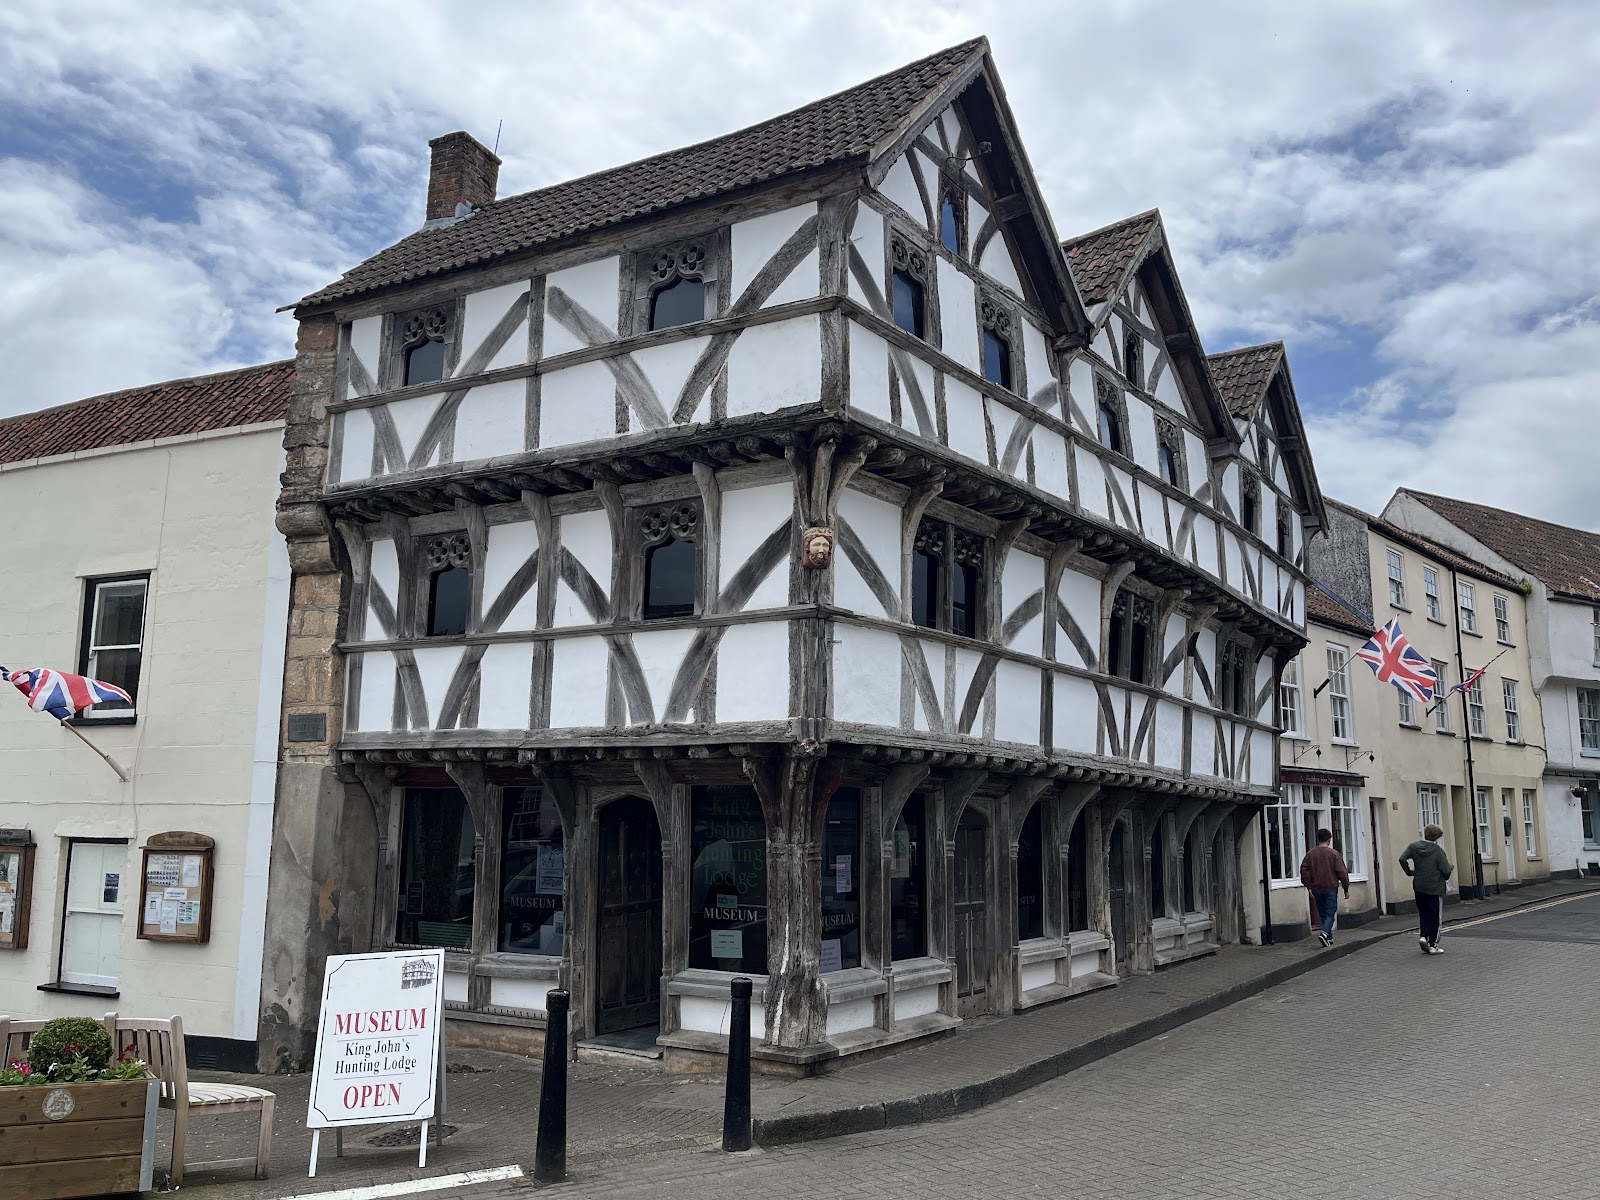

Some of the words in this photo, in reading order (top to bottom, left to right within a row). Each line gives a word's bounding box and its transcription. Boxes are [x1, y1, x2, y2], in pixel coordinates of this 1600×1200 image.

[712, 797, 751, 823] King
[705, 820, 757, 839] John's
[699, 841, 763, 871] Hunting
[703, 866, 758, 894] Lodge
[510, 896, 556, 909] MUSEUM
[703, 907, 758, 922] MUSEUM
[333, 1007, 427, 1035] MUSEUM
[345, 1042, 371, 1058] King
[374, 1038, 411, 1054] John's
[335, 1058, 381, 1075] Hunting
[383, 1056, 417, 1073] Lodge
[343, 1082, 402, 1110] OPEN
